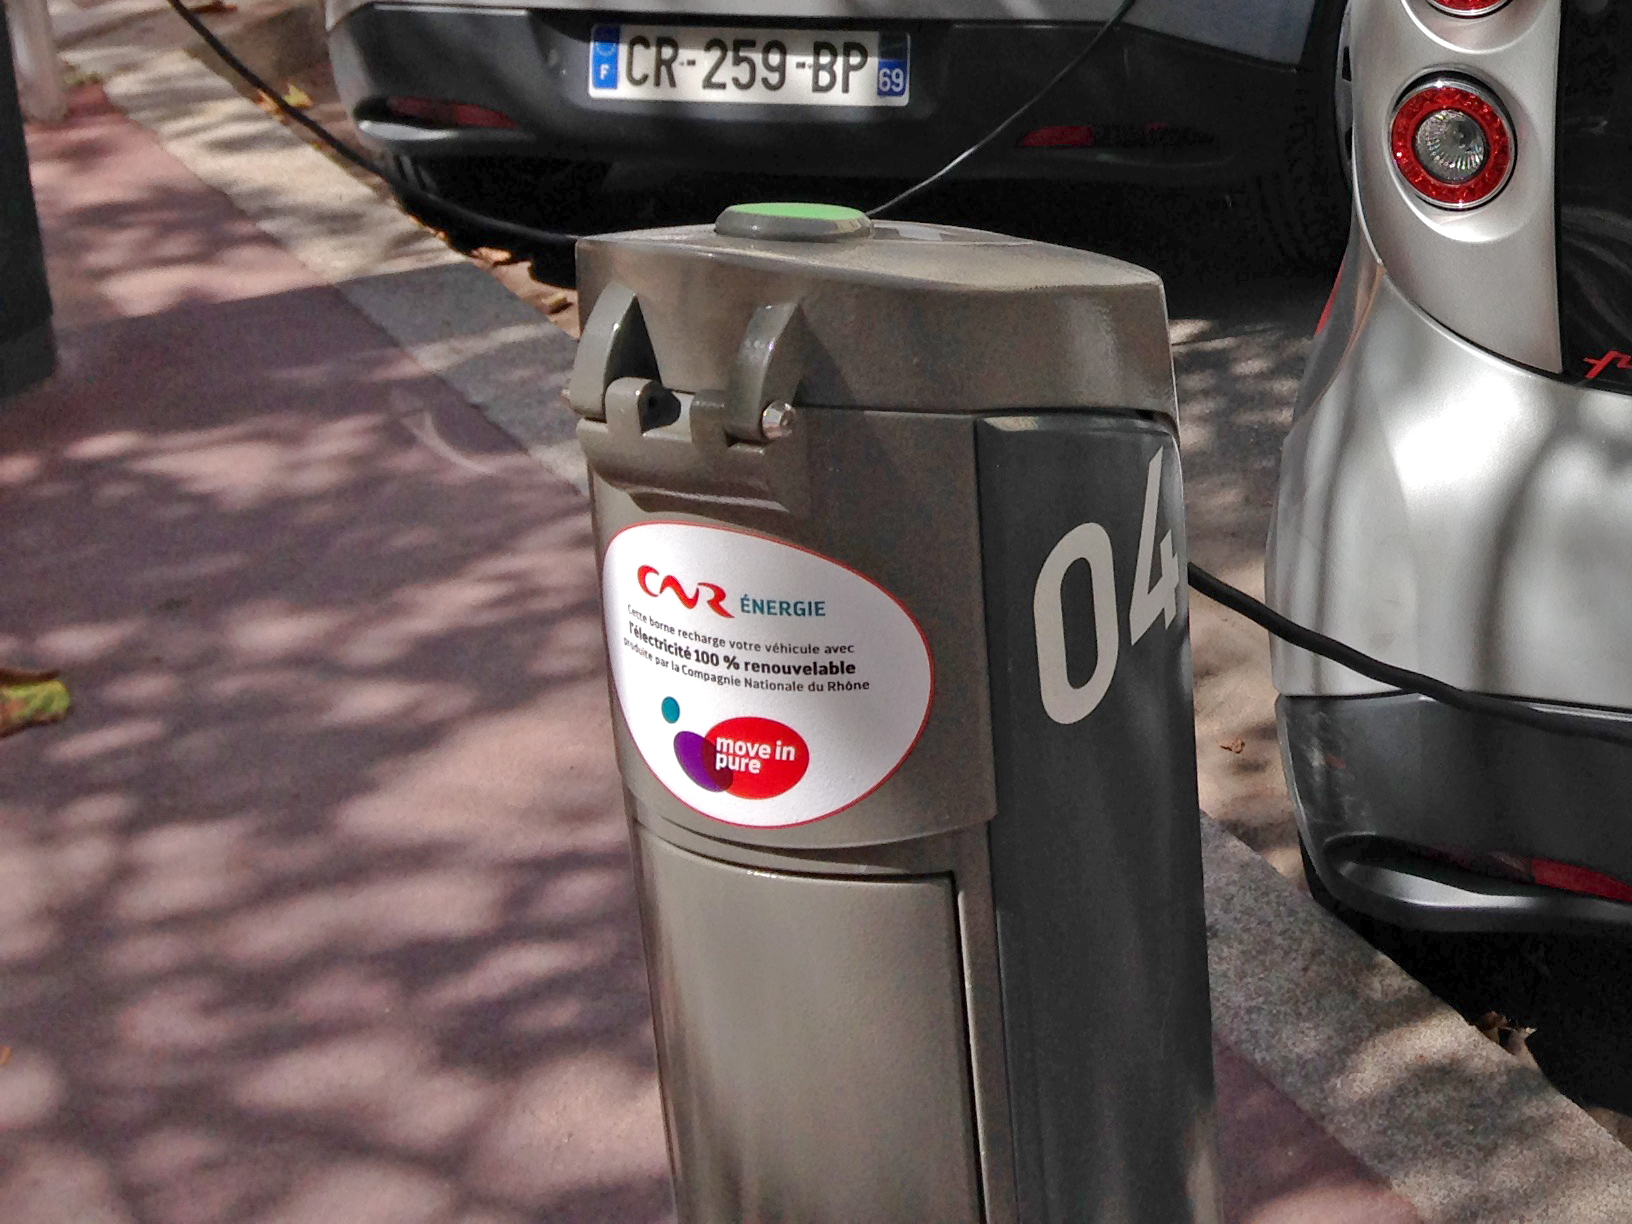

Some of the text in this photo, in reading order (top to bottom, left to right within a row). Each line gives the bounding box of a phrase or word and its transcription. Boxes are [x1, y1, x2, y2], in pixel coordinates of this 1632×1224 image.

[600, 35, 905, 94] F CR-259-BP 69
[1033, 445, 1179, 725] 04
[740, 593, 826, 617] ÉNERGIE
[627, 604, 855, 654] Cette borne recharge votre véhicule avec
[623, 636, 870, 692] produite par la Compagnie Nationale du Rhône
[694, 649, 720, 667] 100
[723, 654, 740, 671] %
[744, 660, 856, 676] renouvelable
[715, 736, 796, 761] move in
[715, 752, 762, 774] pure
